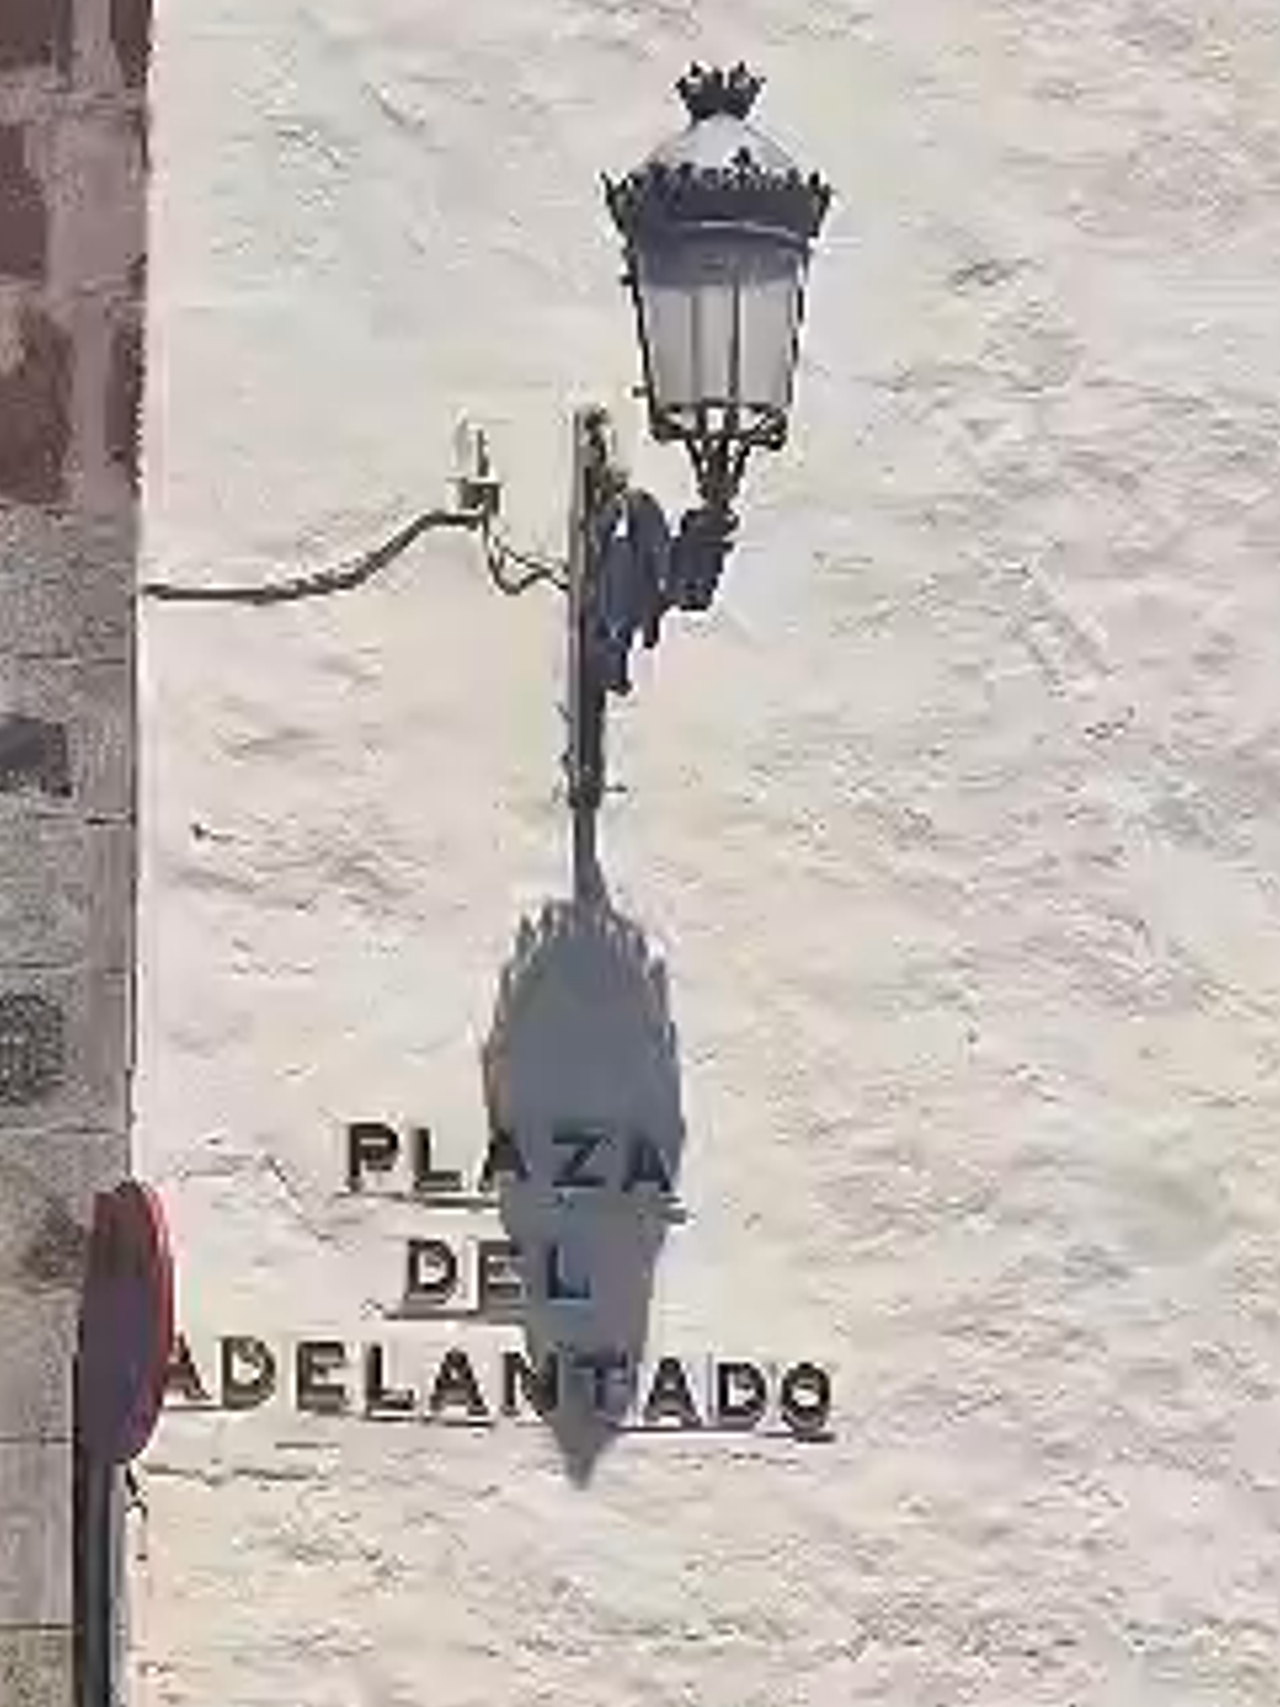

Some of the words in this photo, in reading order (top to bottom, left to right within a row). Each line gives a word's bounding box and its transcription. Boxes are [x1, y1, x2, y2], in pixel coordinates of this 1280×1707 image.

[346, 1121, 676, 1195] PLAZA
[405, 1238, 592, 1305] DEL
[164, 1333, 833, 1433] ADELANTADO
